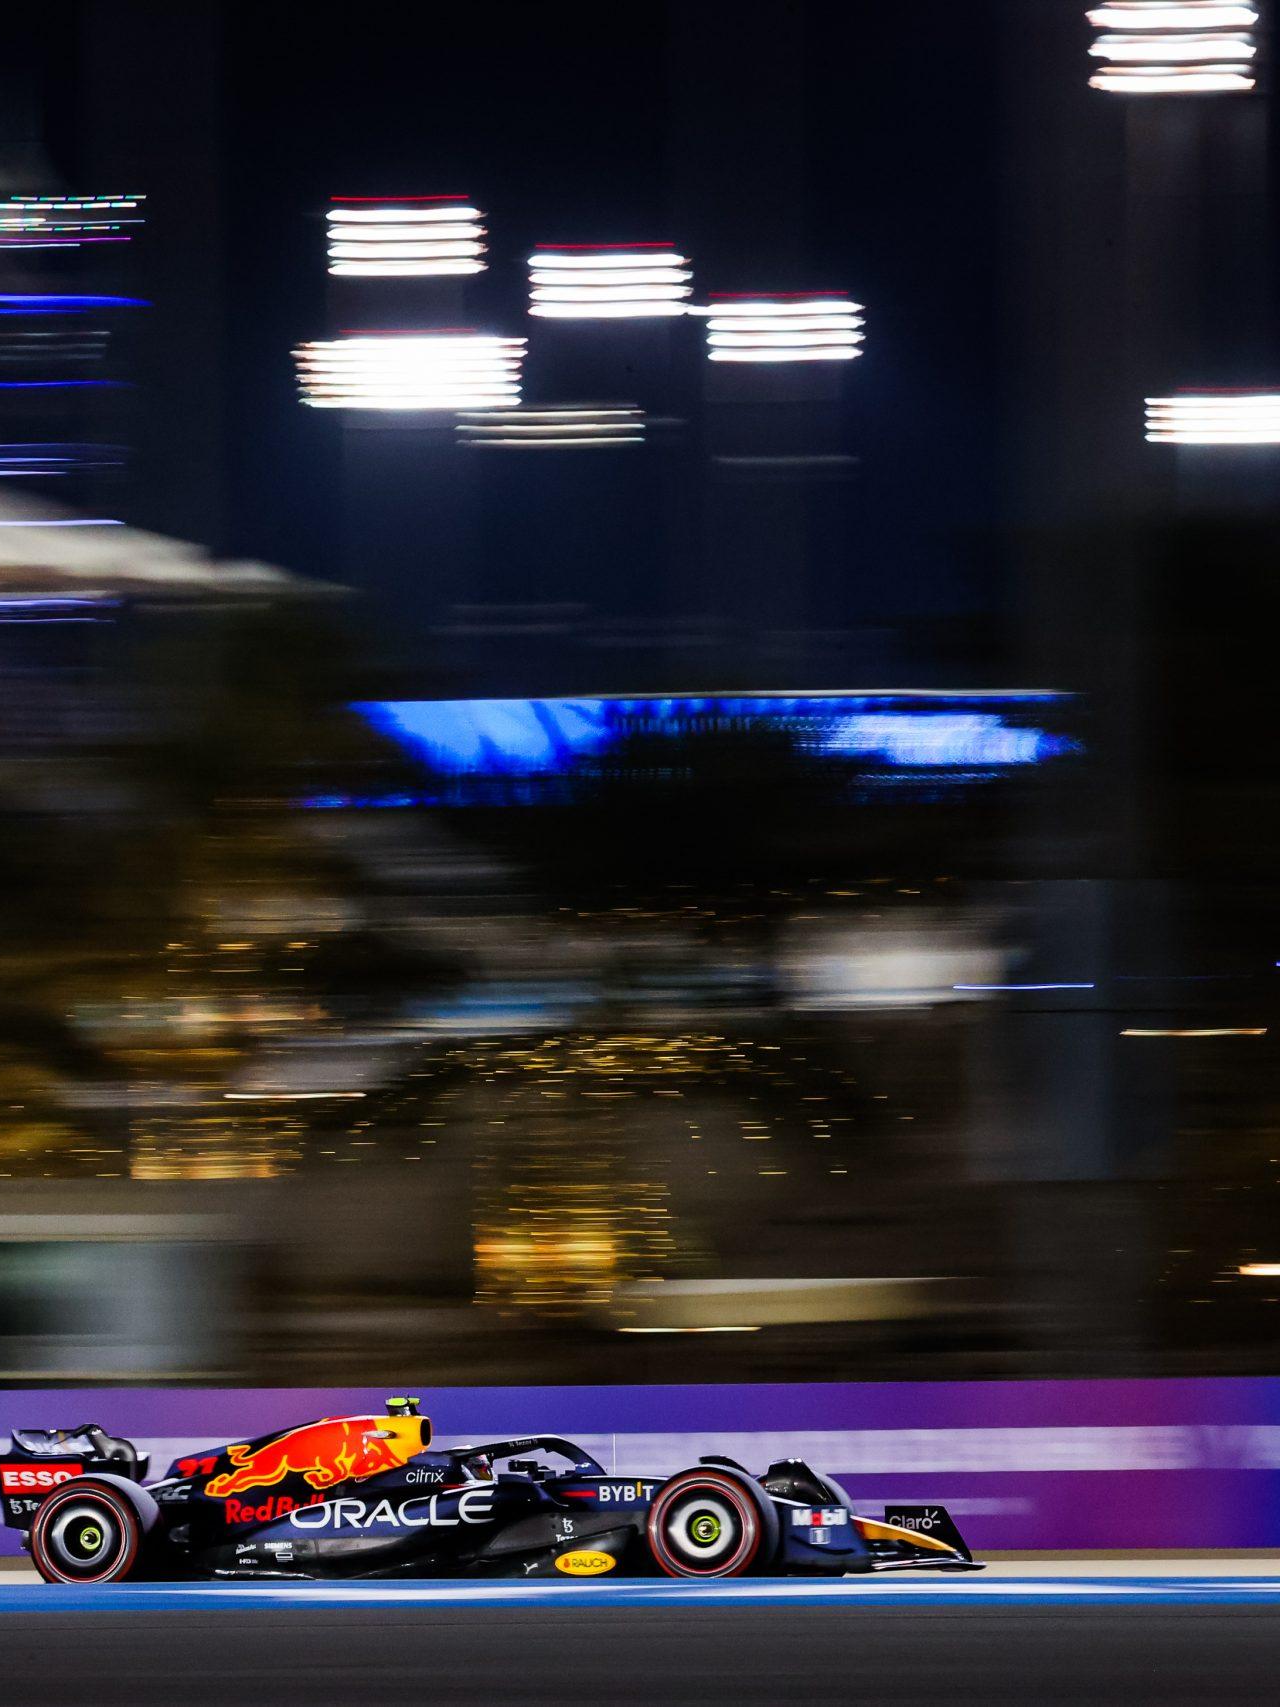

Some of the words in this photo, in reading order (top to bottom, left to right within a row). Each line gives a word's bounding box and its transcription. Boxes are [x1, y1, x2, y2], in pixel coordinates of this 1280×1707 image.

[2, 1471, 73, 1487] ESSO
[405, 1469, 444, 1484] citrix
[598, 1481, 654, 1502] BYBIT
[225, 1496, 274, 1525] Red
[289, 1490, 496, 1530] ORACLE
[791, 1508, 848, 1527] Mobil
[889, 1515, 933, 1531] Claro
[572, 1558, 608, 1568] RAUCH
